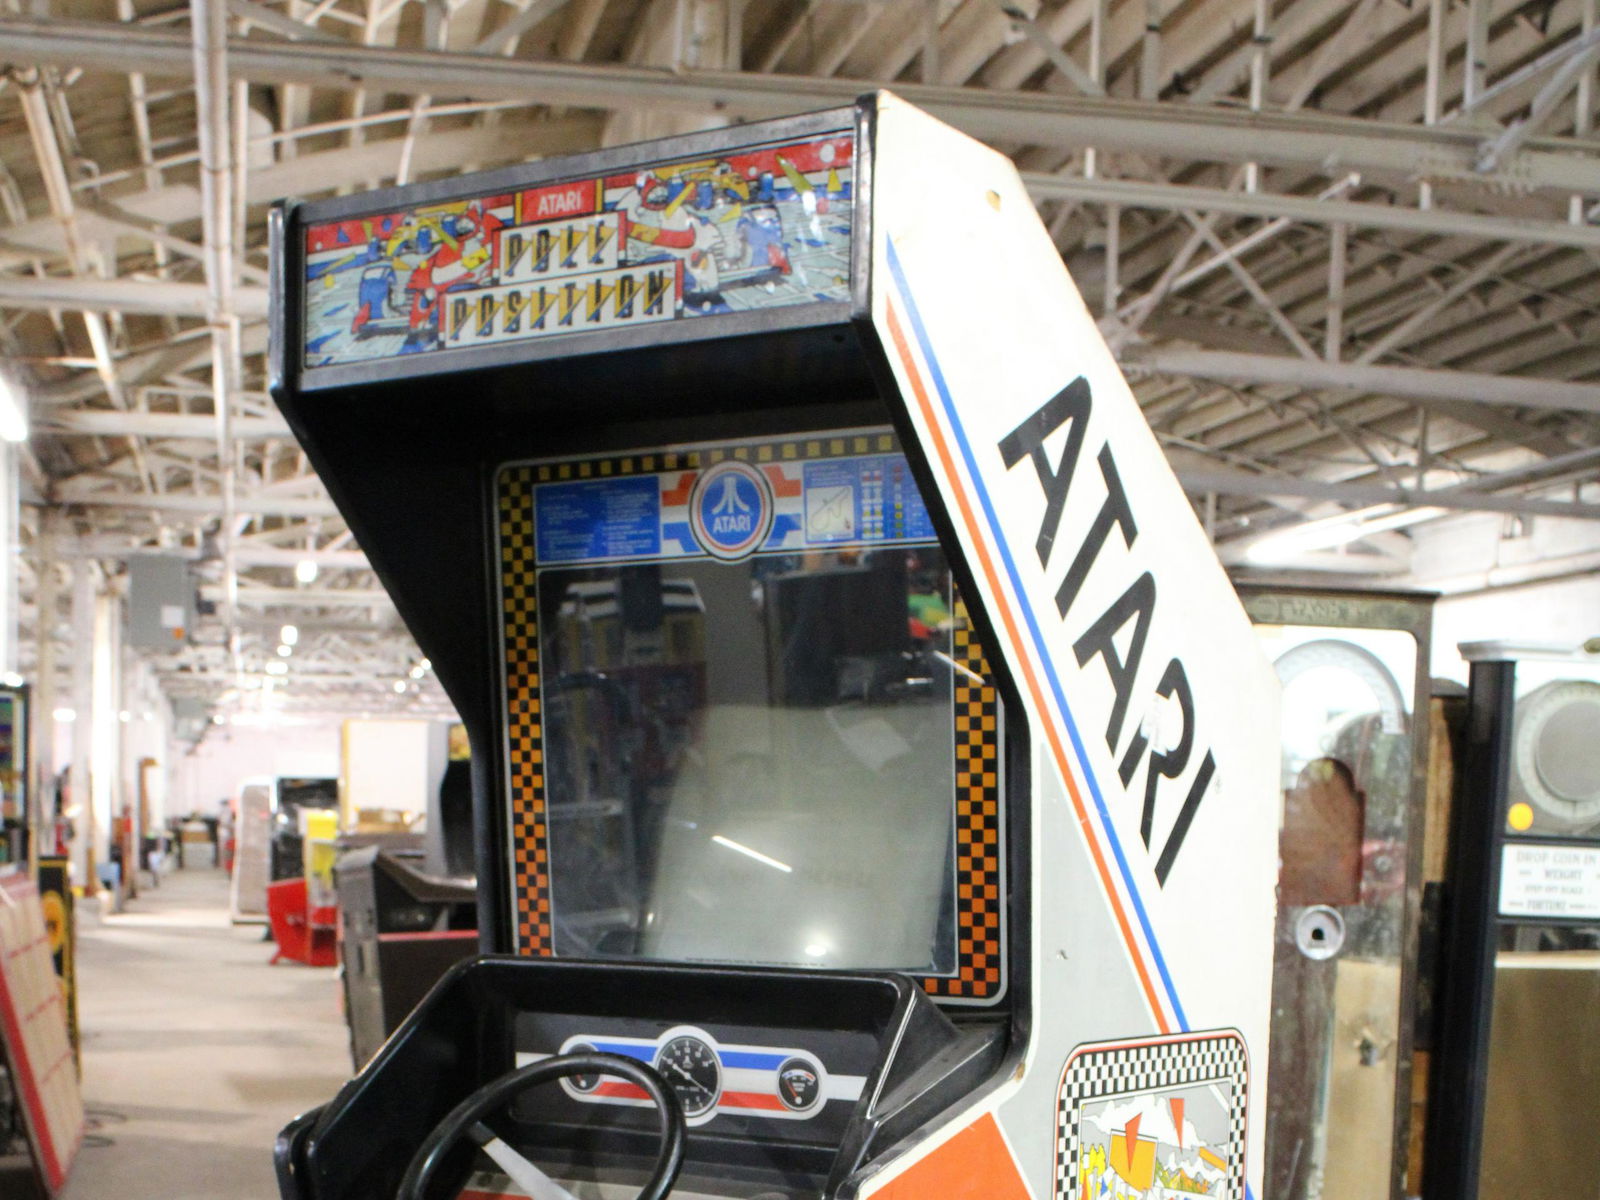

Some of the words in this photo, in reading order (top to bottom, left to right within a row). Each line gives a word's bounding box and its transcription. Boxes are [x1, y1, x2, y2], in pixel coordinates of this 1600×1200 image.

[537, 190, 582, 217] ATARI
[504, 219, 606, 278] POLE
[450, 268, 665, 342] POSITION
[712, 513, 751, 533] ATARI
[998, 375, 1216, 891] ATARI
